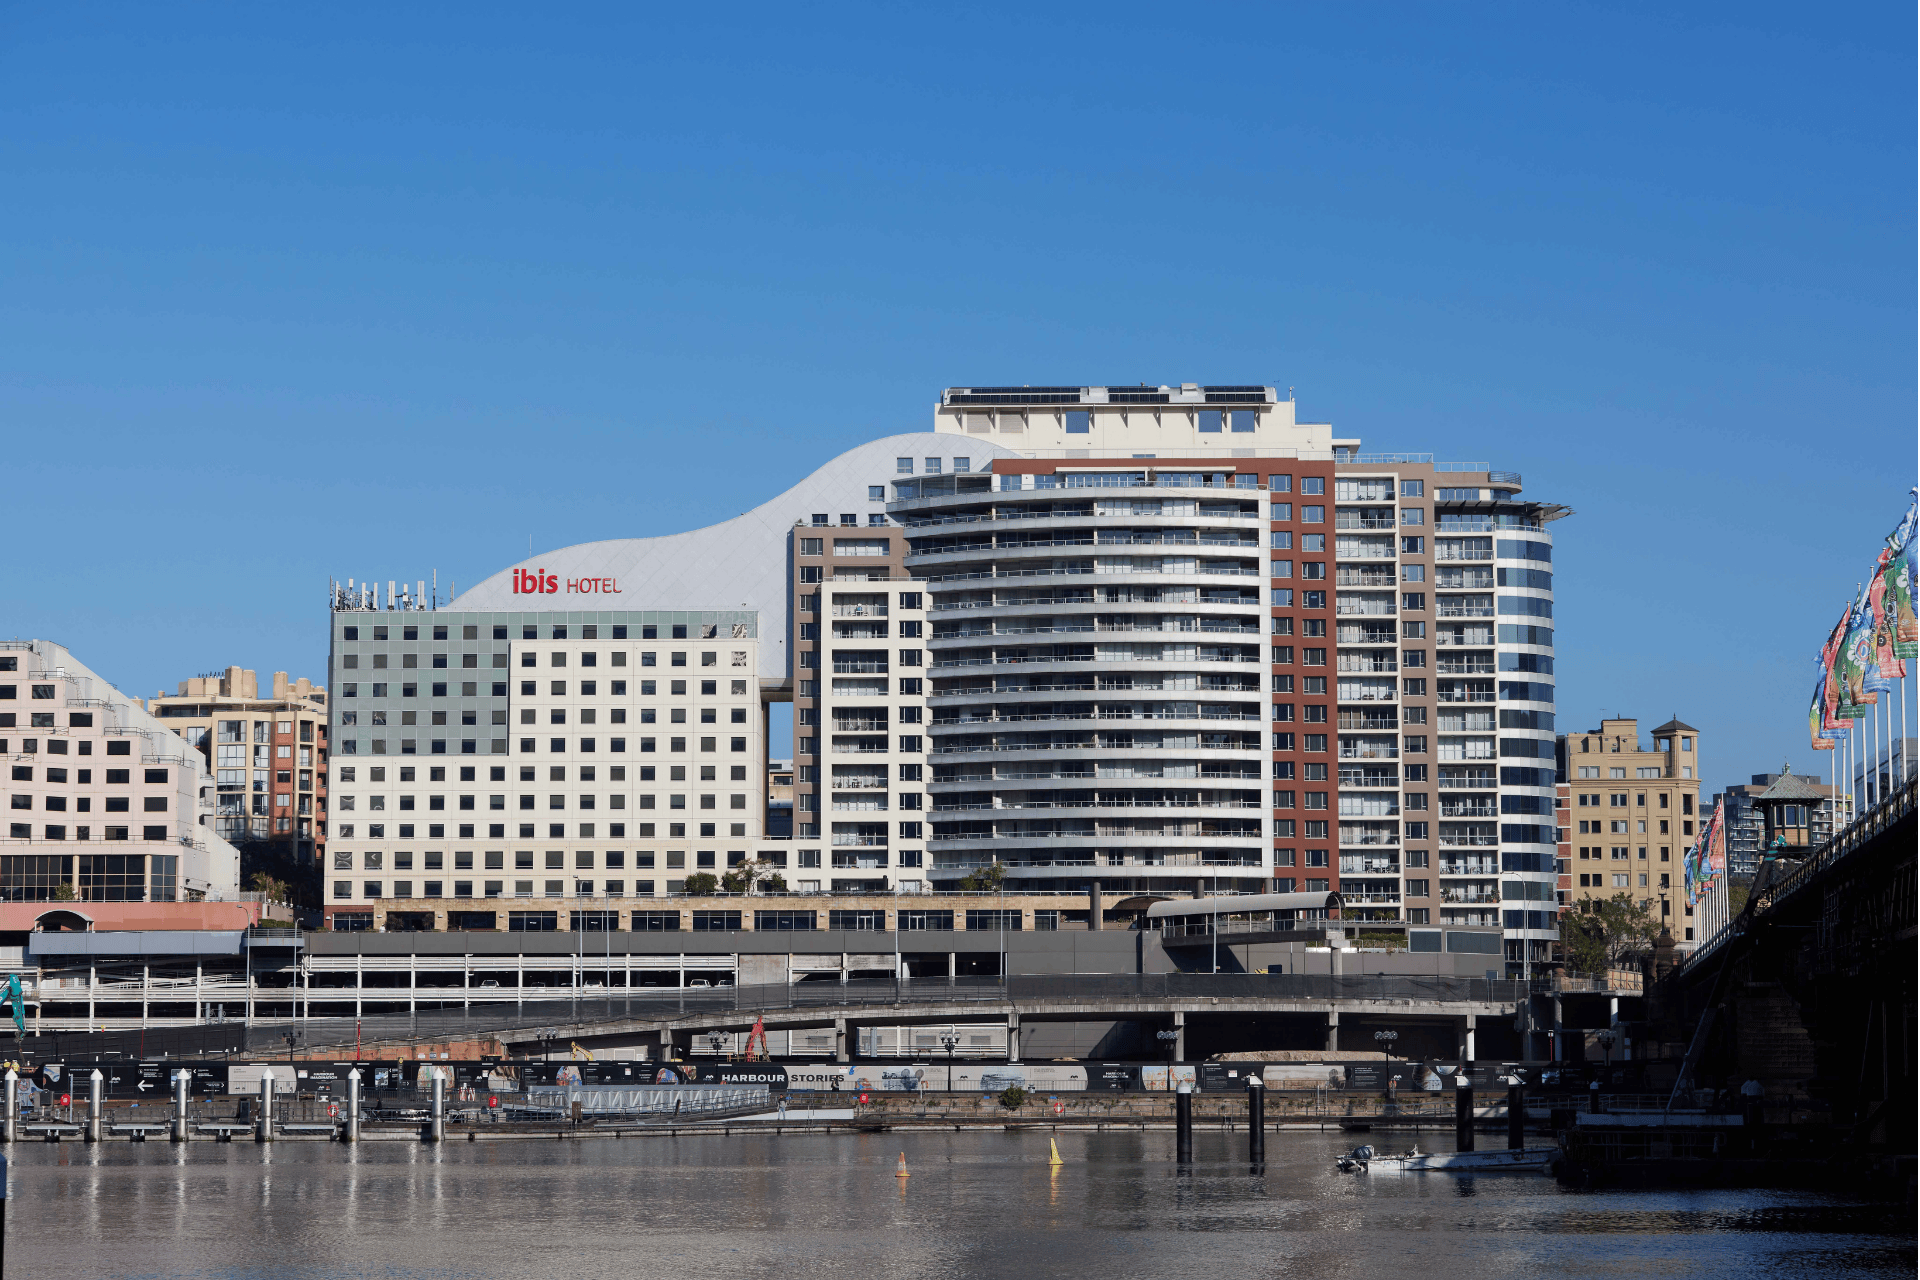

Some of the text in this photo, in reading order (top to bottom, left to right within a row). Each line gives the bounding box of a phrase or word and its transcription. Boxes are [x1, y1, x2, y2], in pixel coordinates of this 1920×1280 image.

[512, 568, 622, 594] ibis HOTEL
[721, 1074, 786, 1082] HARBOUR
